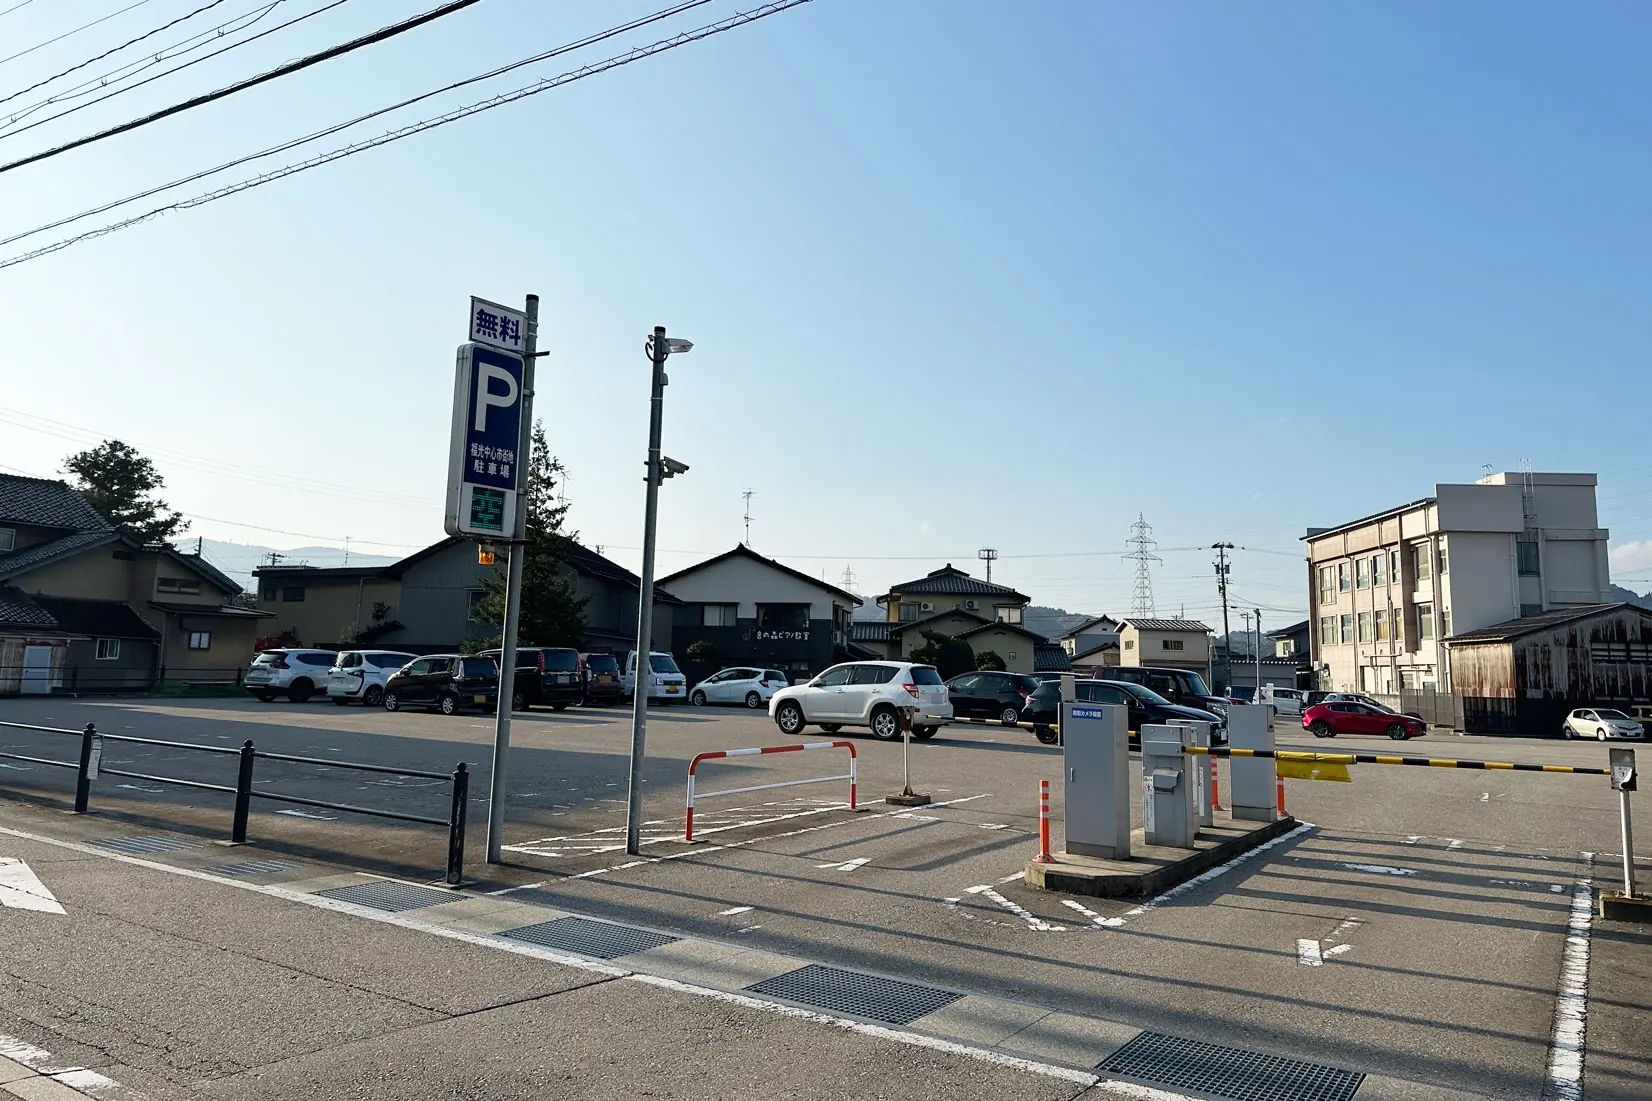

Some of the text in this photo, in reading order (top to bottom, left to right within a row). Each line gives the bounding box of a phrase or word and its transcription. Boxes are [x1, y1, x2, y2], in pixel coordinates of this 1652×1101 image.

[475, 308, 521, 346] 無料
[474, 362, 518, 432] P
[471, 442, 514, 464] 福光中心市街地
[473, 459, 509, 479] 駐車場
